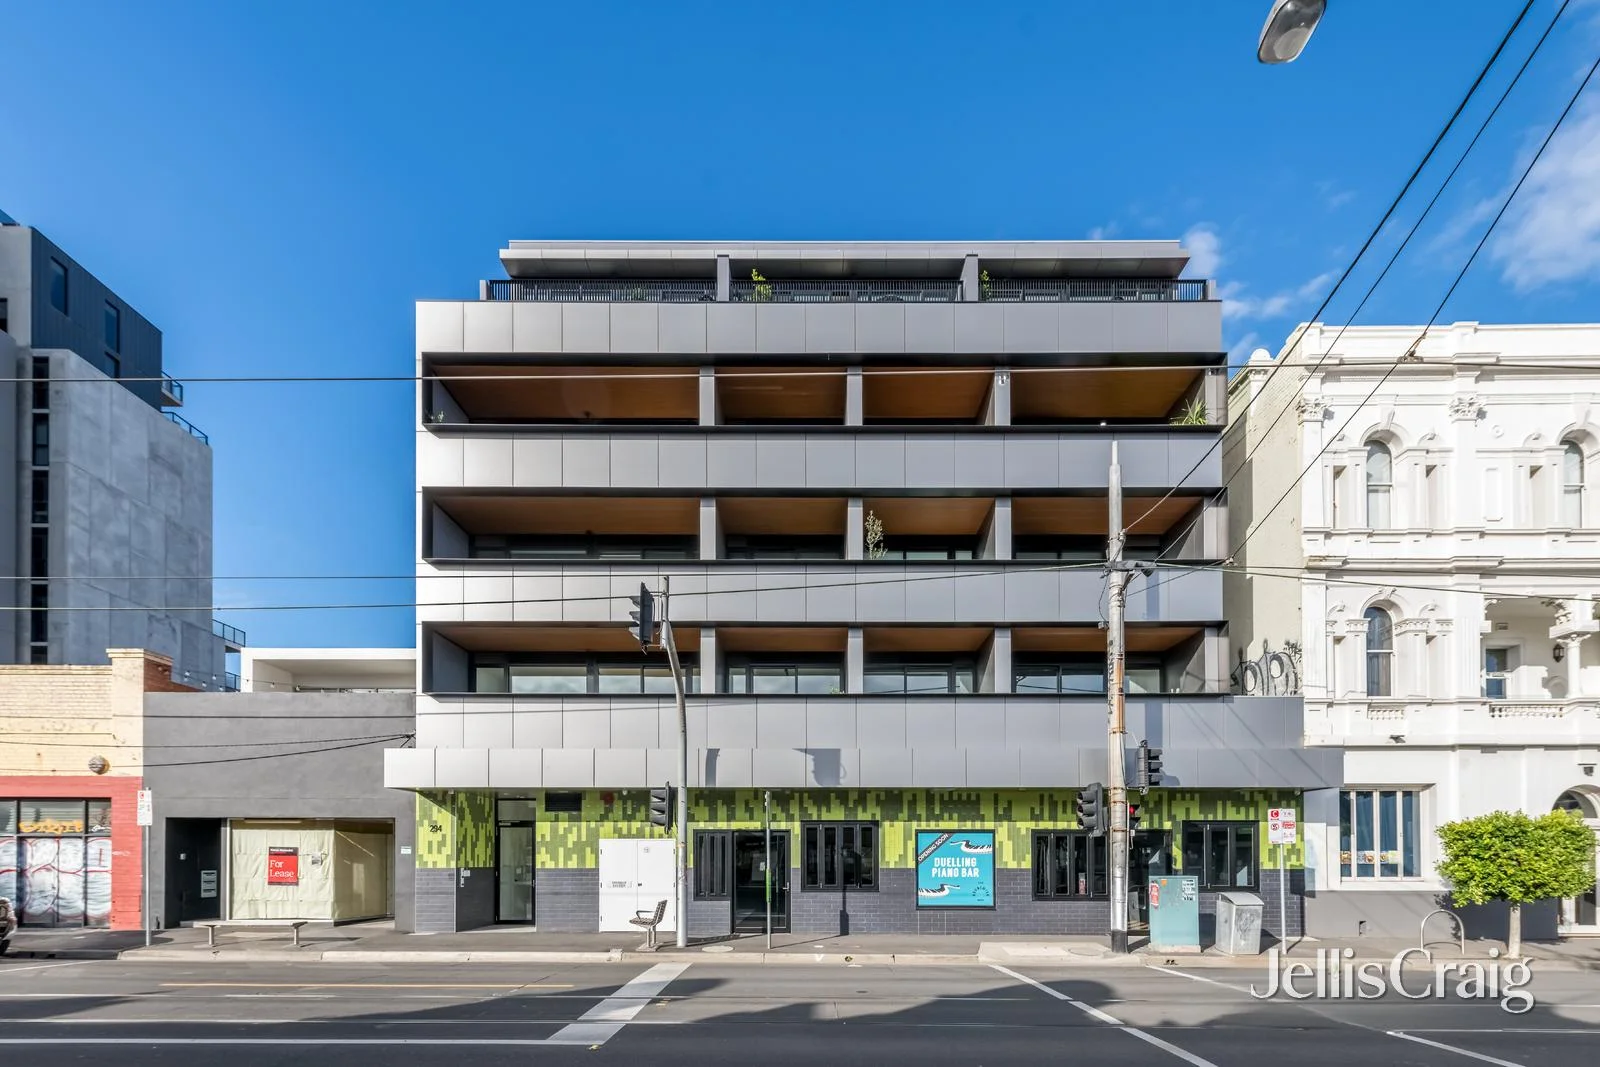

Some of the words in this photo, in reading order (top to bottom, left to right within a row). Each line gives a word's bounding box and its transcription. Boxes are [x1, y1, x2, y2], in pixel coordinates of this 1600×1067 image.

[430, 825, 442, 833] 294
[918, 845, 936, 861] OPENING
[935, 834, 949, 846] SOON
[270, 860, 284, 868] For
[934, 857, 977, 867] DUELLING
[270, 869, 294, 878] Lease
[931, 867, 959, 878] PIANO
[961, 867, 980, 878] BAR
